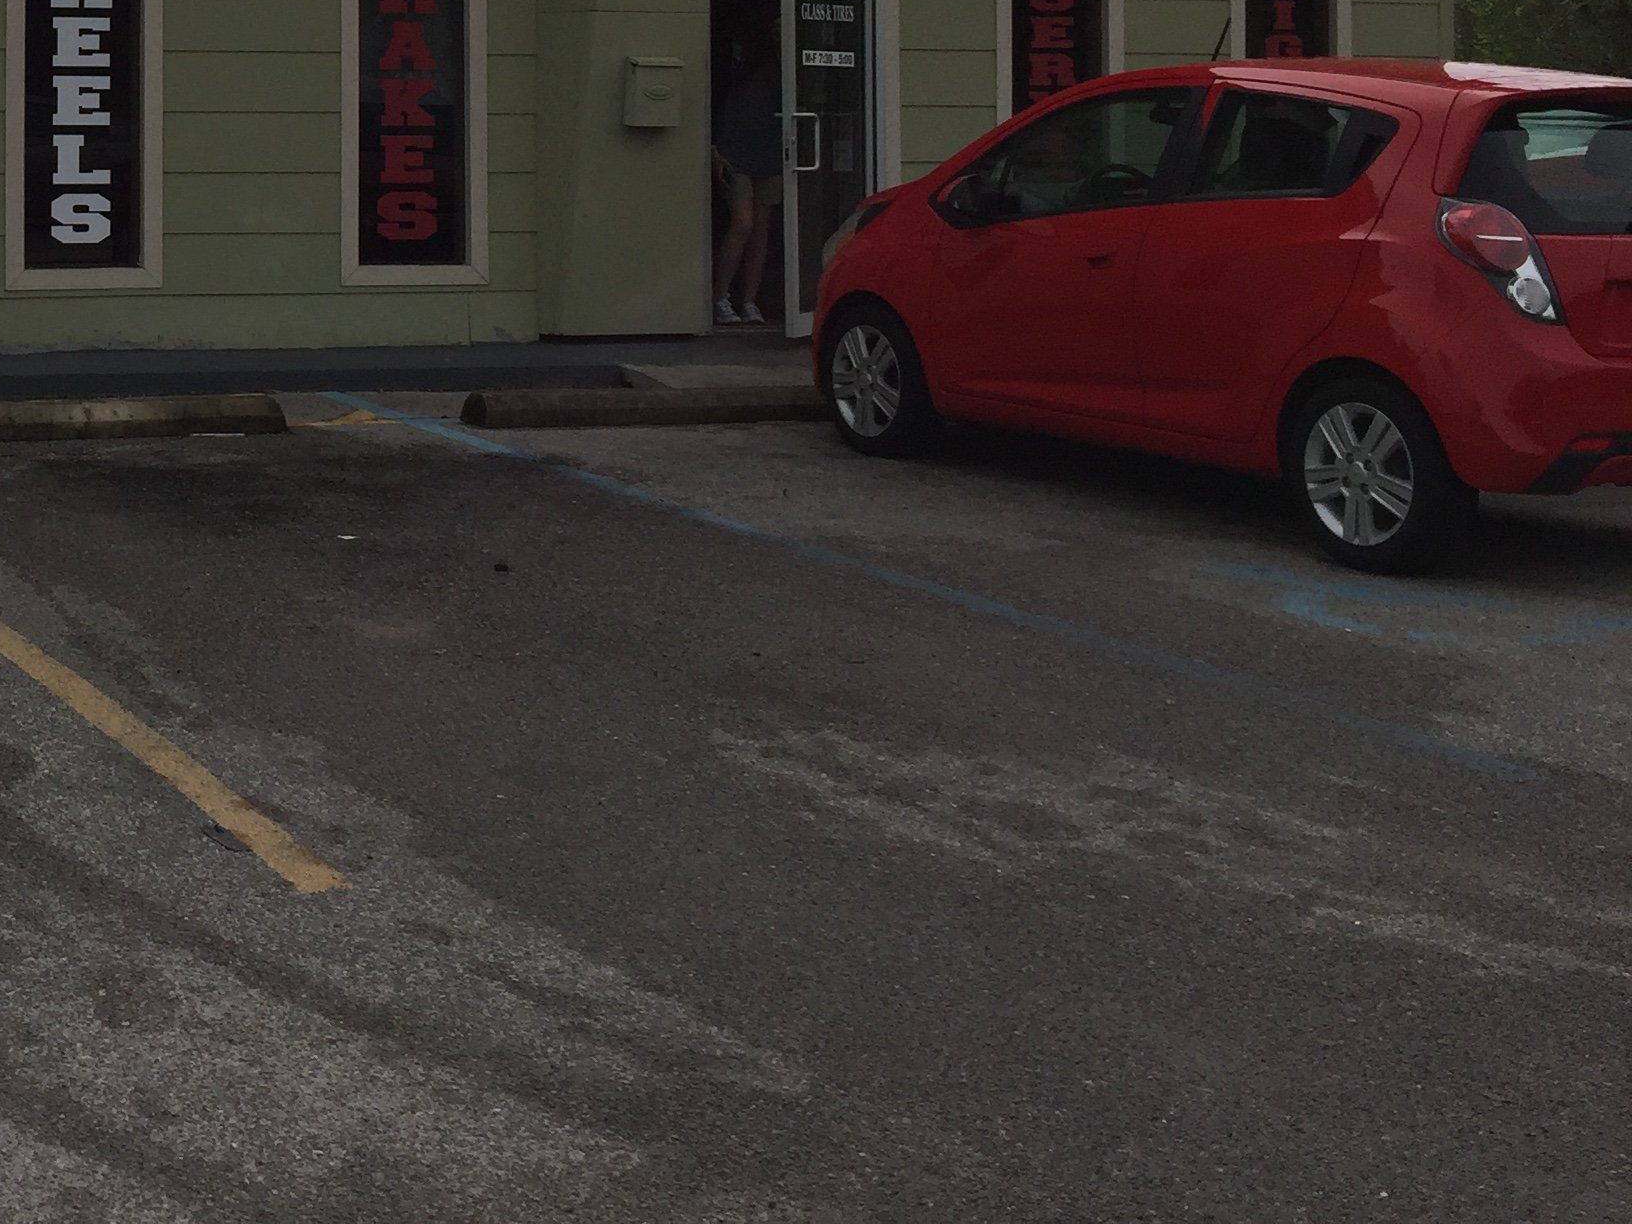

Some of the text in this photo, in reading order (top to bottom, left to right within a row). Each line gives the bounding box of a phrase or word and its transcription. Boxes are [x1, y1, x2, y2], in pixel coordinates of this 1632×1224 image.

[801, 2, 854, 23] GLASS & TIRES
[804, 52, 817, 64] M-F
